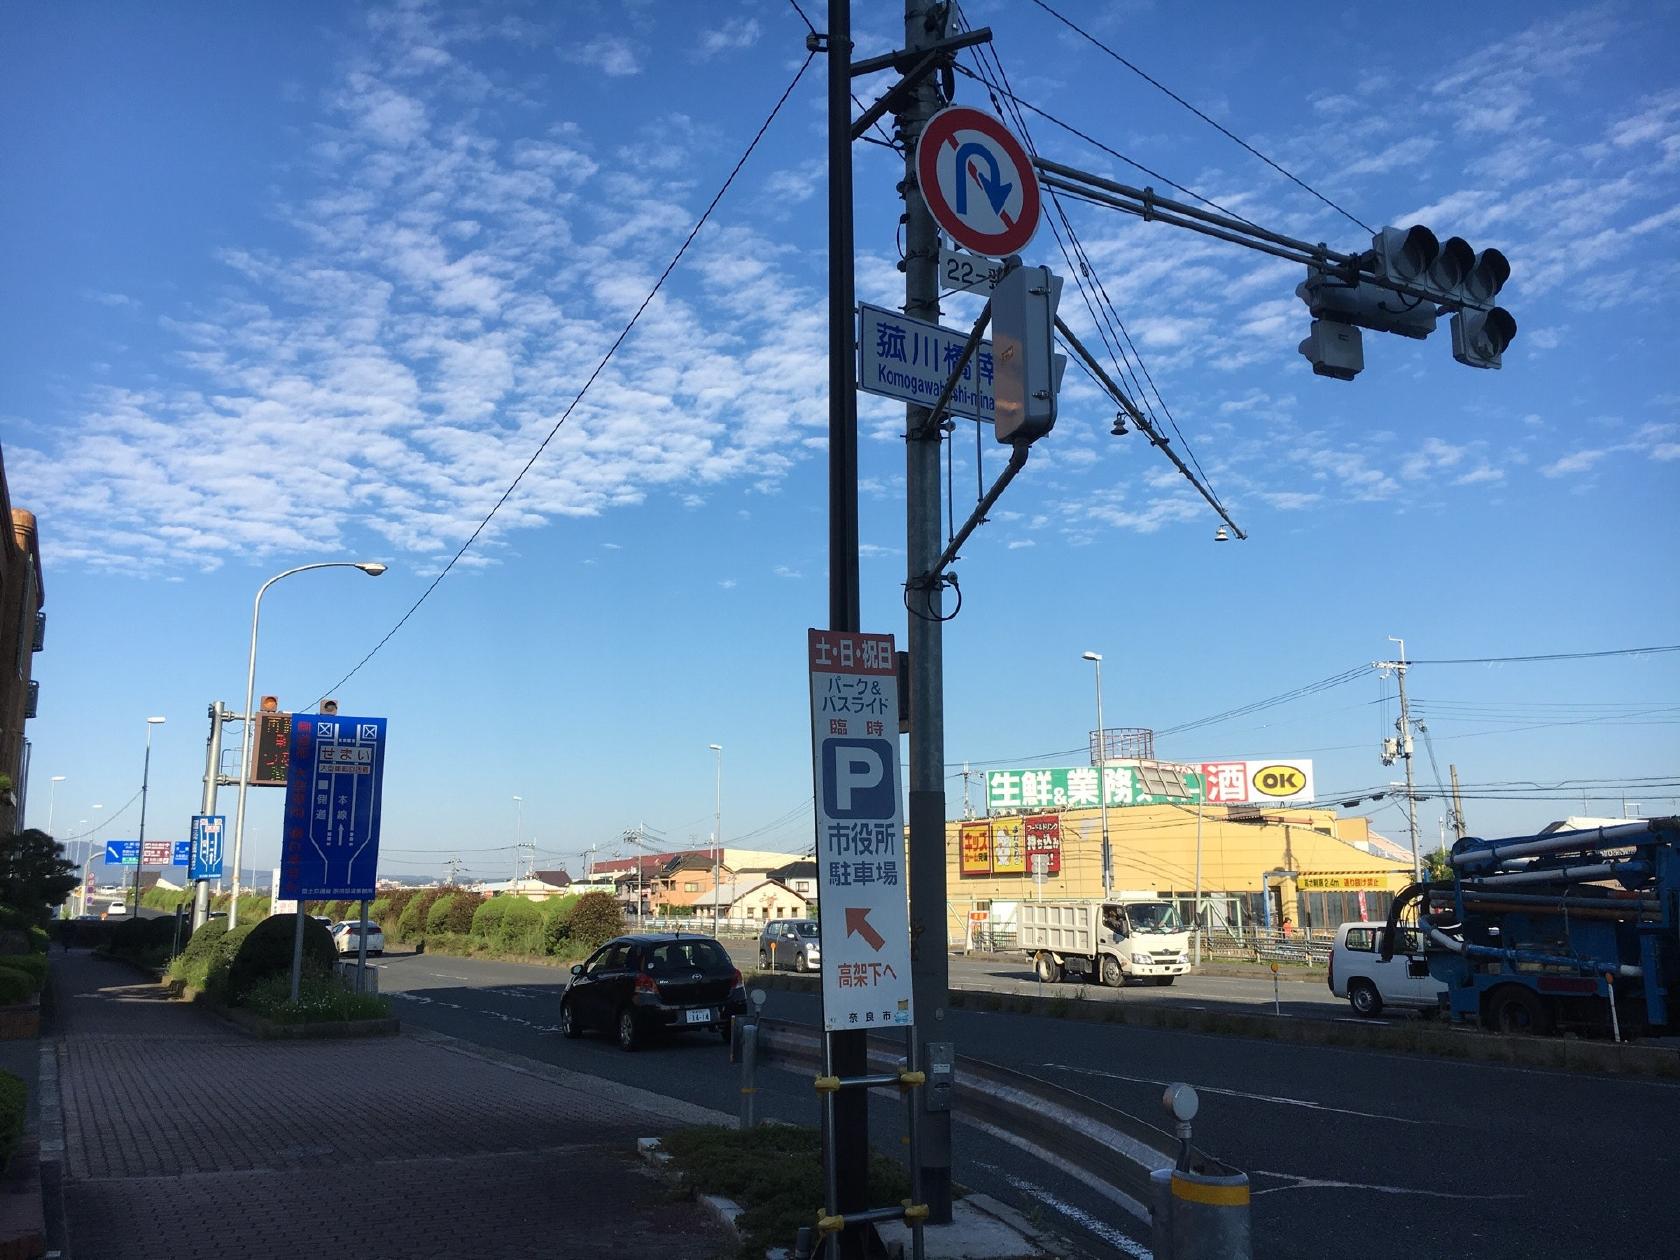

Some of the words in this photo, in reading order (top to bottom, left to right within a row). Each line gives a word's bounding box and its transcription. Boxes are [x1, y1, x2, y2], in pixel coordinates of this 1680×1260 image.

[878, 363, 996, 412] Komogawabshi-mina
[828, 676, 881, 696] パーク&
[822, 695, 889, 715] バスライド
[321, 747, 370, 760] せまい
[835, 746, 883, 810] P
[991, 768, 1200, 807] 生鮮&業務スー
[1208, 763, 1247, 802] 酒
[1263, 773, 1297, 789] OK
[828, 822, 895, 856] 市役所
[1027, 833, 1059, 850] 持ち込み
[829, 861, 898, 887] 駐車場
[837, 962, 897, 988] 高架下へ
[848, 1011, 891, 1023] 奈良市
